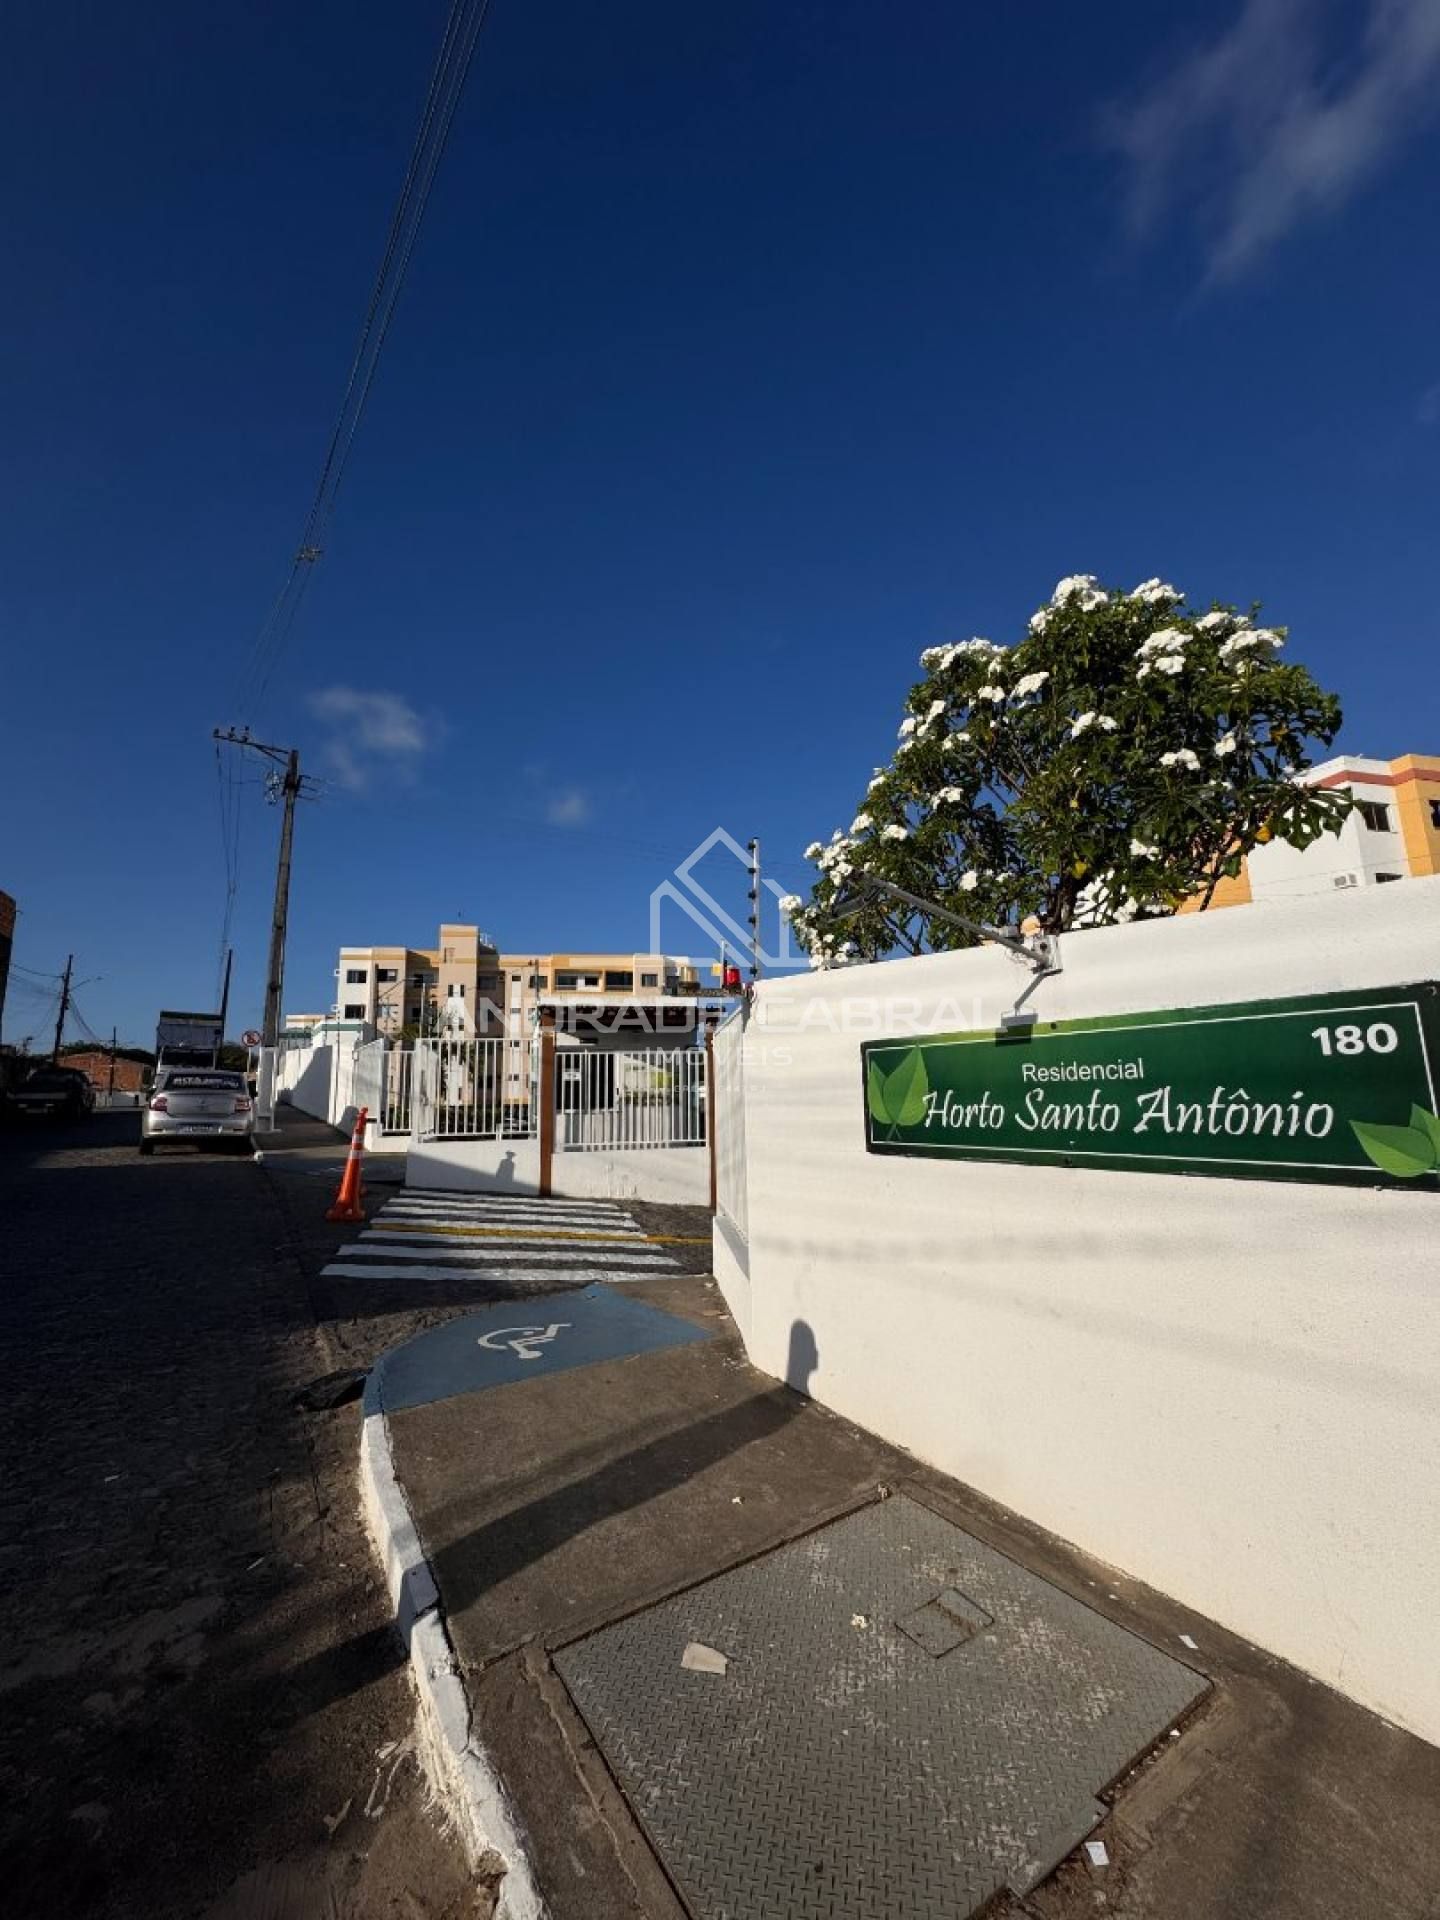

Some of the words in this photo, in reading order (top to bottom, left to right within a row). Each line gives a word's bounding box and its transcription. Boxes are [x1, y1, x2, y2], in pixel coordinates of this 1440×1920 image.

[1311, 1023, 1398, 1056] 180
[1022, 1057, 1144, 1081] Residencial
[922, 1090, 1003, 1129] Horto
[1015, 1088, 1119, 1132] Santo
[1133, 1086, 1334, 1137] Antônio
